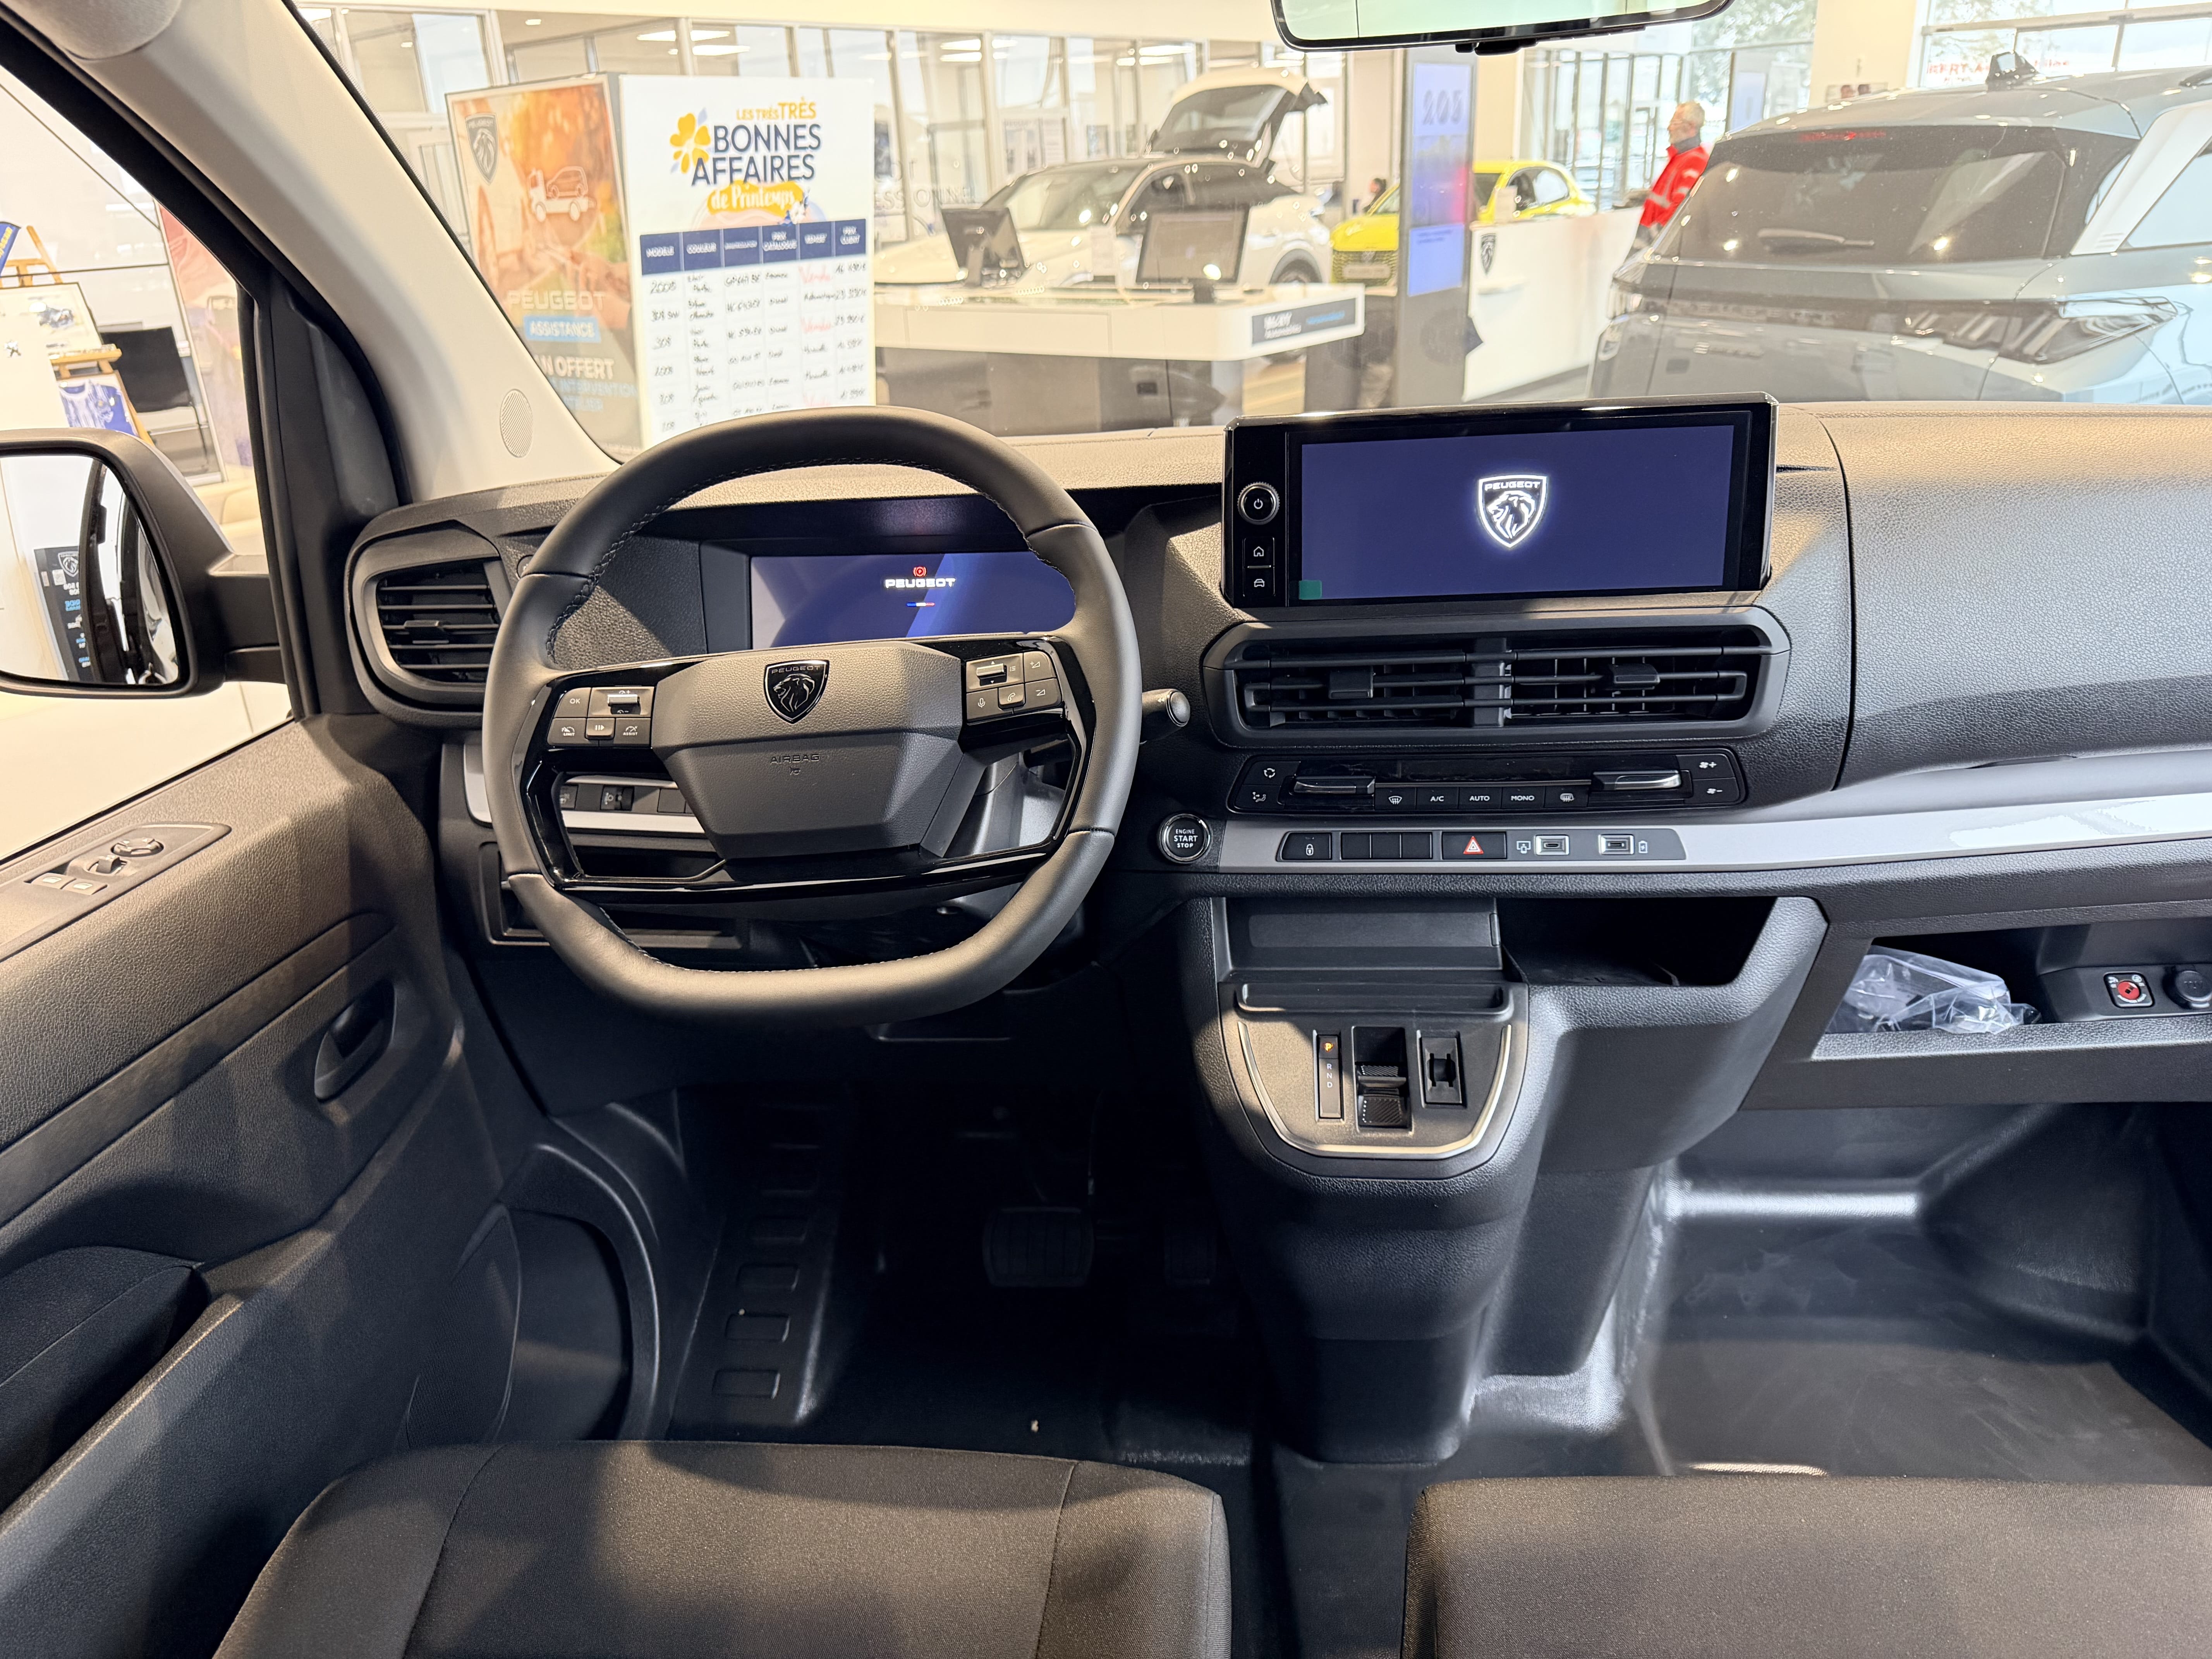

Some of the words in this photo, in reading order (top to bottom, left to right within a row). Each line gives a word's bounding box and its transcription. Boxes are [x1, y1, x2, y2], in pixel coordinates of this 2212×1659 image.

[736, 109, 754, 120] LES
[778, 96, 817, 120] TRÈS
[714, 124, 821, 153] BONNES
[691, 154, 816, 186] AFFAIRES
[711, 190, 730, 210] de
[730, 184, 795, 211] Printemps
[507, 290, 605, 310] PEUGEOT
[530, 321, 595, 337] ASSISTANCE
[555, 356, 614, 380] OFFERT
[1484, 481, 1541, 491] PEUGEOT
[885, 578, 956, 589] PEUGEOT
[771, 666, 821, 674] PEUGEOT
[770, 754, 820, 764] AIRBAG
[1325, 1042, 1333, 1051] P
